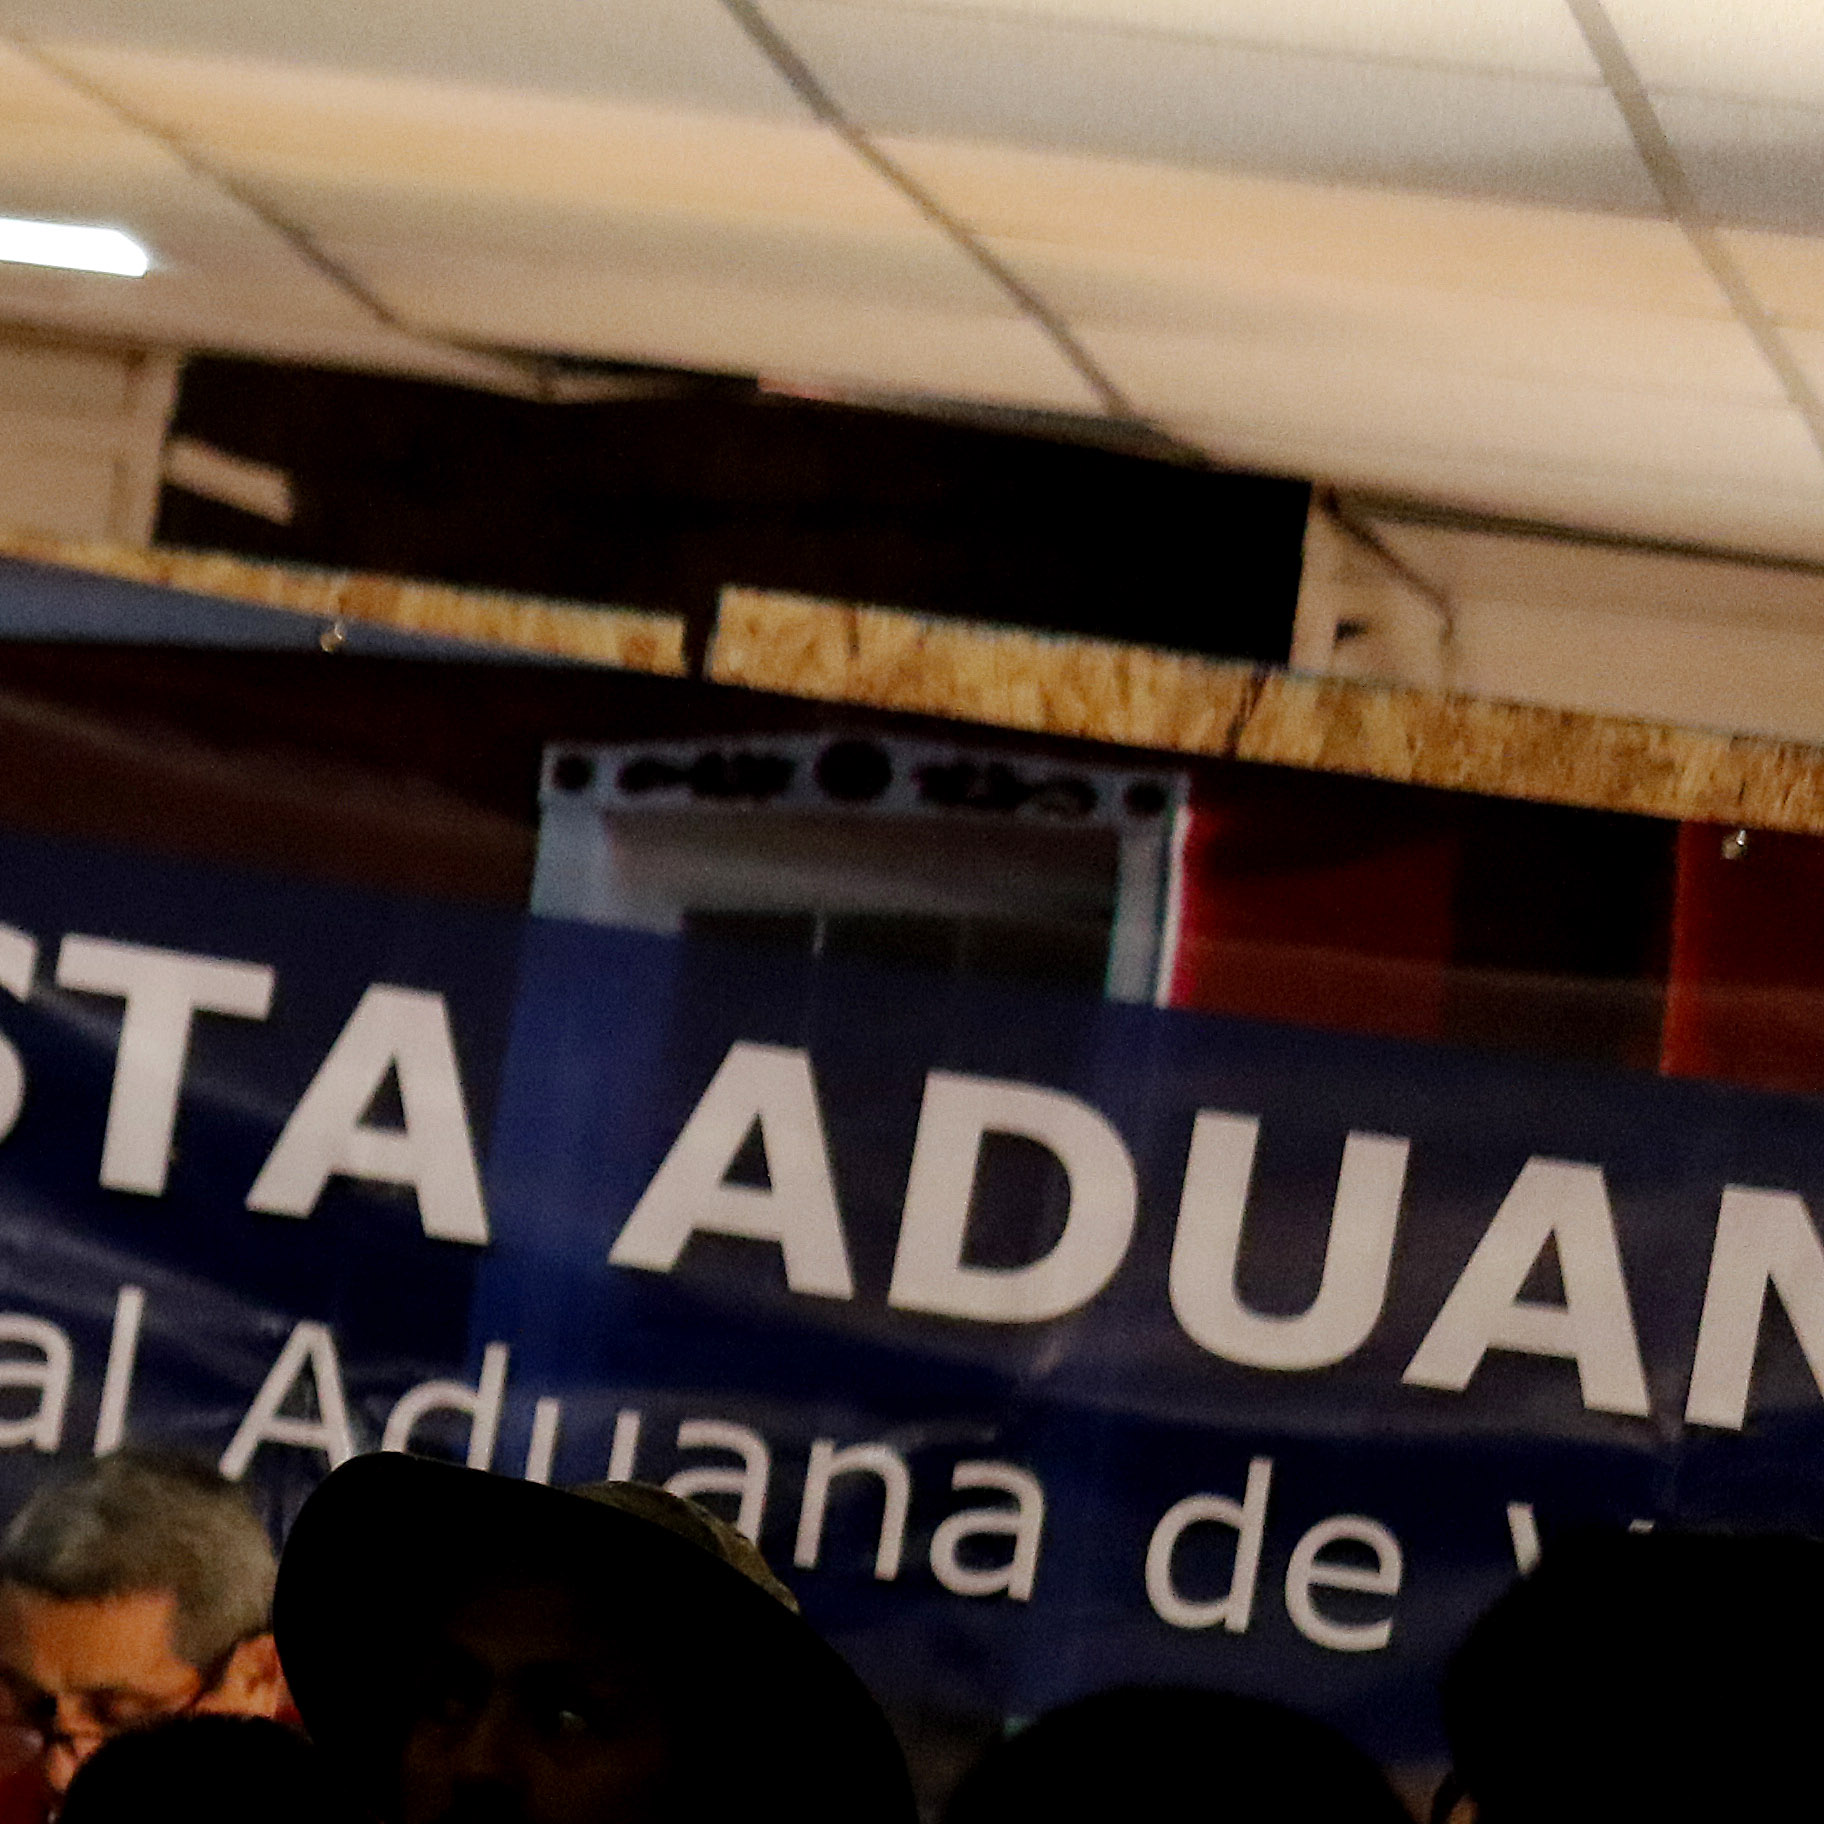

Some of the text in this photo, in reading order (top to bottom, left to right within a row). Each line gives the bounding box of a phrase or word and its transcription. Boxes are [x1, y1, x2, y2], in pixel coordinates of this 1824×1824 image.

[607, 1040, 1824, 1432] ADUAN
[216, 1318, 1048, 1604] Aduana
[1142, 1455, 1406, 1652] de
